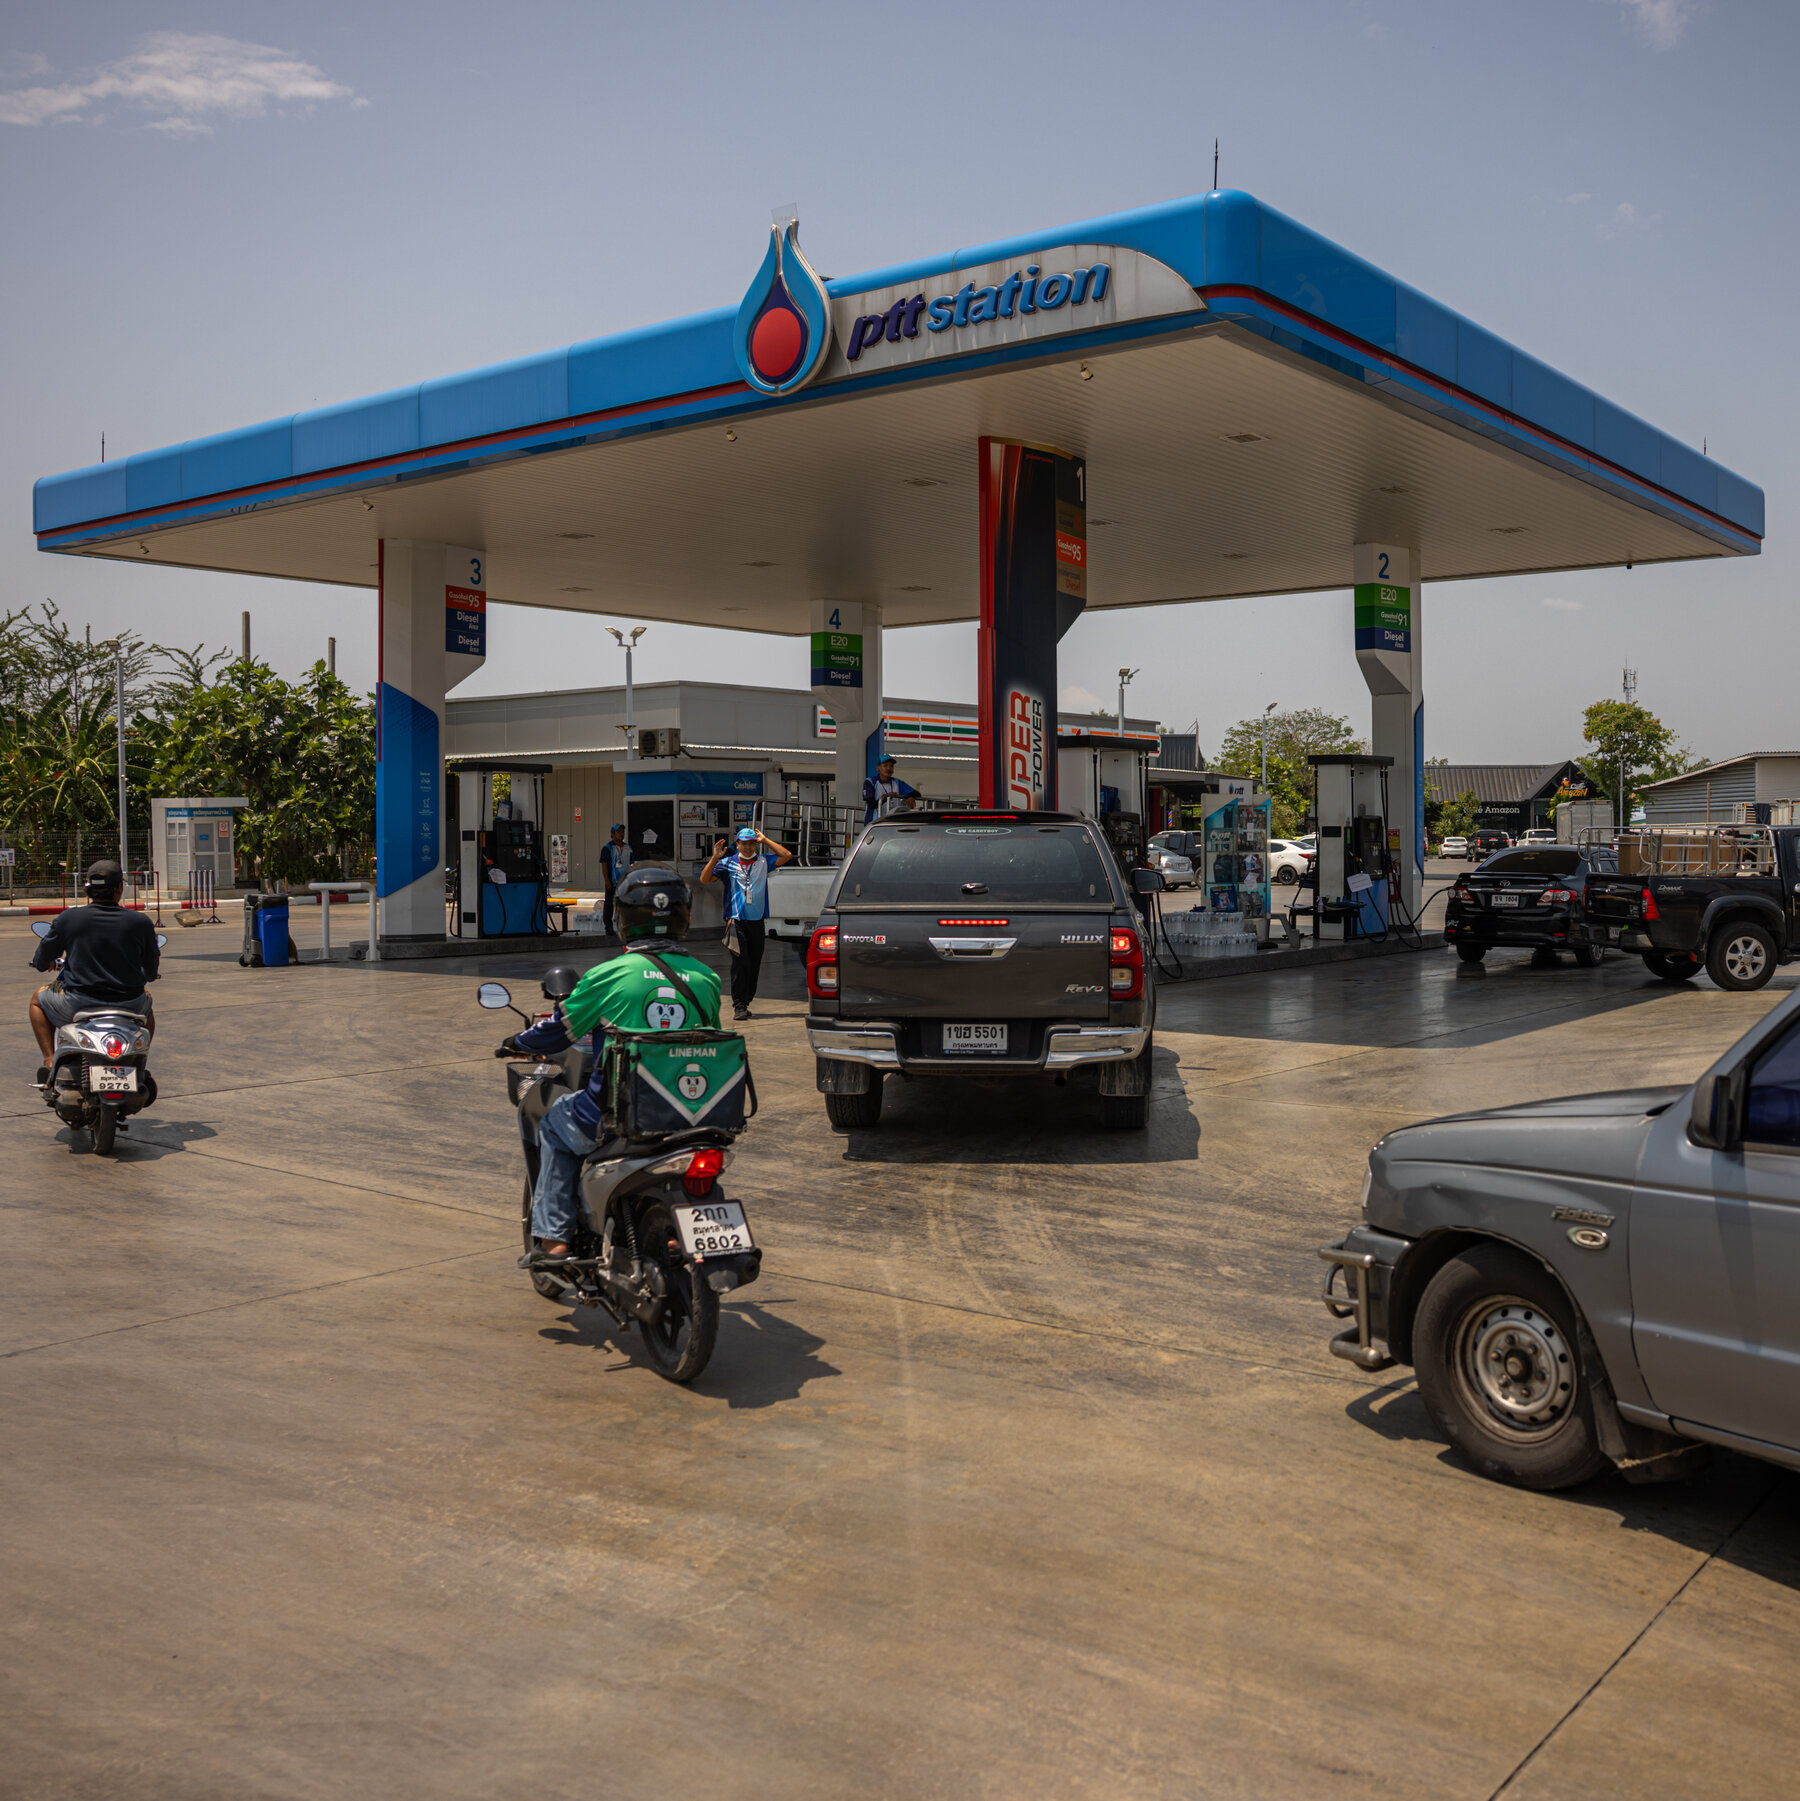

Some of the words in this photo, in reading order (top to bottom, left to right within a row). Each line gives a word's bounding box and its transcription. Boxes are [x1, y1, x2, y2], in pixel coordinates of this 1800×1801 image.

[846, 293, 927, 362] ptt
[926, 263, 1110, 333] station
[1076, 466, 1083, 502] 1
[1057, 539, 1072, 551] Gasohol
[1072, 544, 1082, 561] 95
[470, 558, 481, 585] 3
[1378, 552, 1390, 579] 2
[448, 591, 468, 601] Gasohol
[468, 594, 480, 608] 95
[1380, 587, 1397, 601] E20
[456, 611, 479, 624] Diesel
[828, 608, 842, 630] 4
[1397, 613, 1408, 626] 91
[458, 635, 480, 647] Diesel
[831, 635, 848, 647] E20
[1384, 630, 1404, 642] Diesel
[830, 654, 849, 662] Gasohol
[849, 656, 860, 667] 91
[830, 671, 851, 680] Diesel
[1010, 690, 1031, 810] UPER
[1032, 699, 1042, 792] POWER
[733, 780, 757, 790] Cashier
[1484, 806, 1520, 814] Amazon
[843, 935, 874, 943] TOYOTA
[1060, 935, 1104, 944] HILUX
[643, 970, 690, 982] LINEN
[974, 1026, 1004, 1039] 5501
[952, 1042, 998, 1050] กรุงเทพมหานคร
[691, 1206, 728, 1222] 2กก
[694, 1234, 742, 1251] 6802
